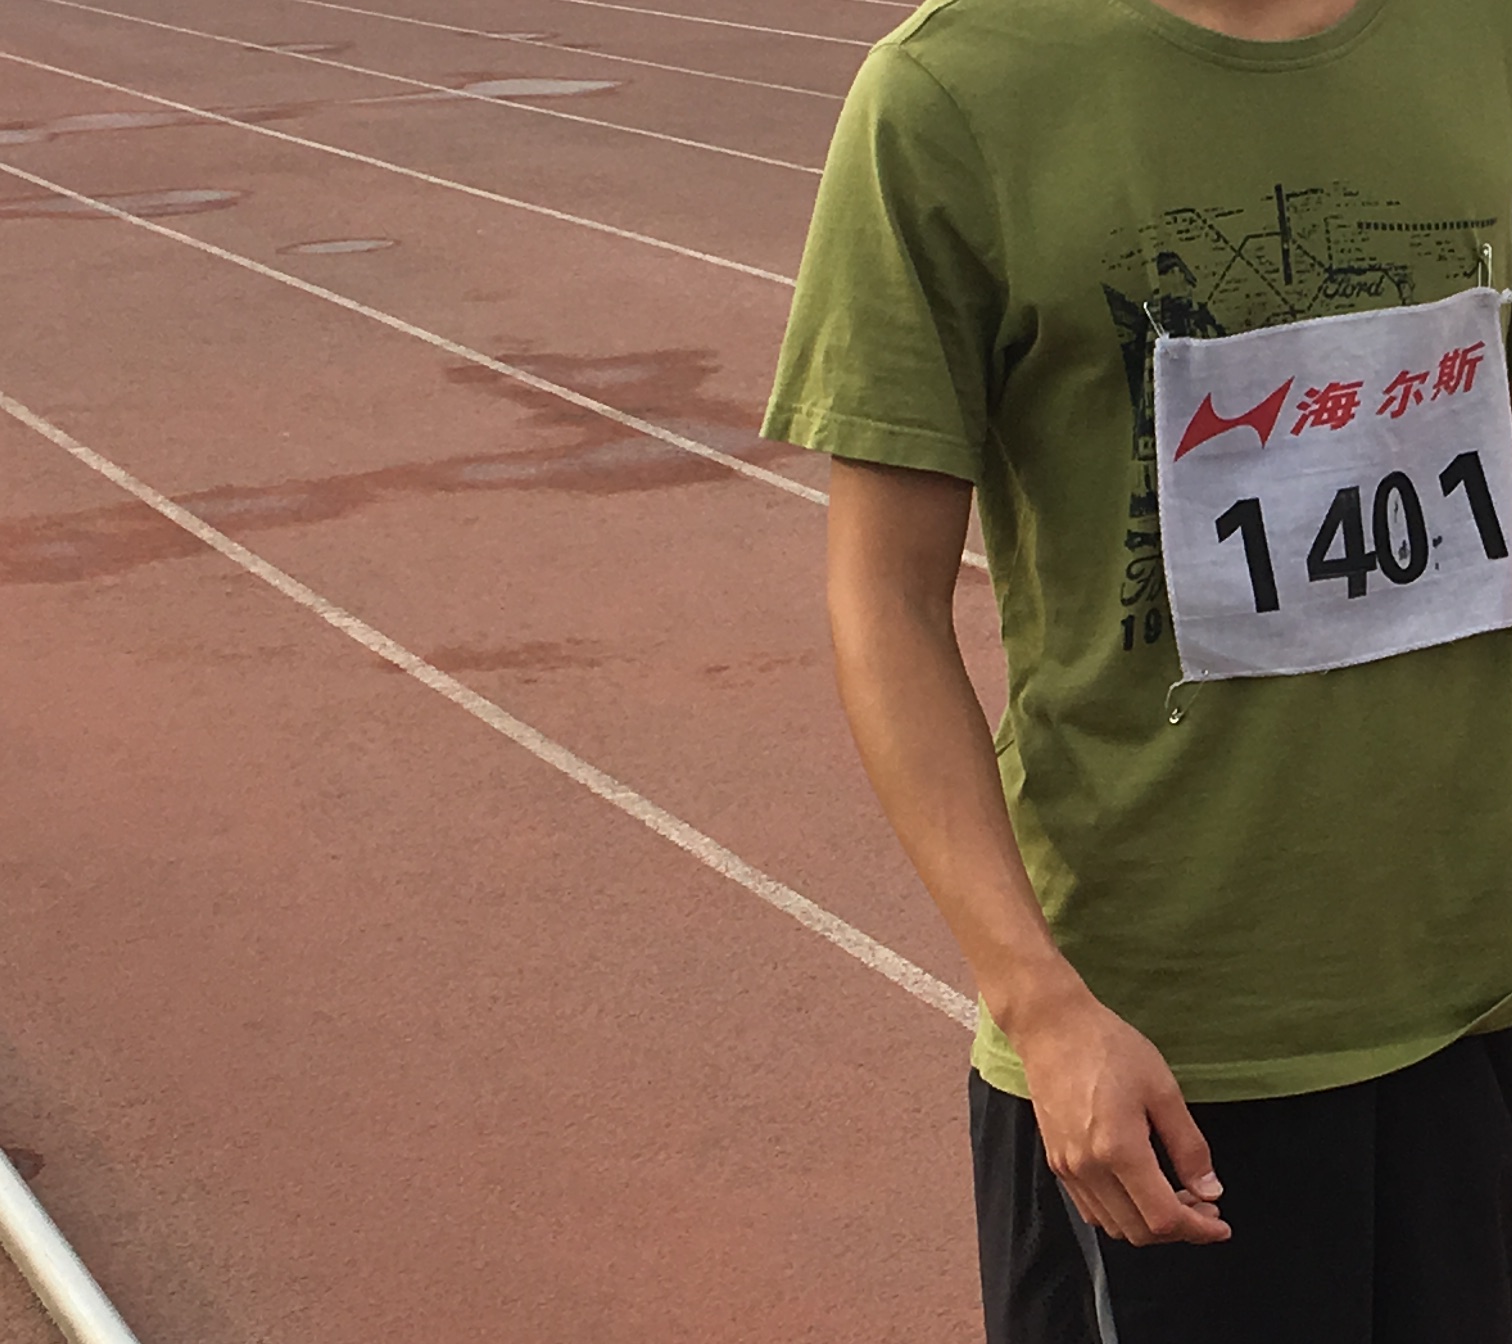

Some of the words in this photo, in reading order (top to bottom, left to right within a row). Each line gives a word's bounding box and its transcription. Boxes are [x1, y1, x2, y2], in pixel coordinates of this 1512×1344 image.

[1290, 340, 1486, 436] 海尔斯
[1214, 450, 1509, 613] 1401
